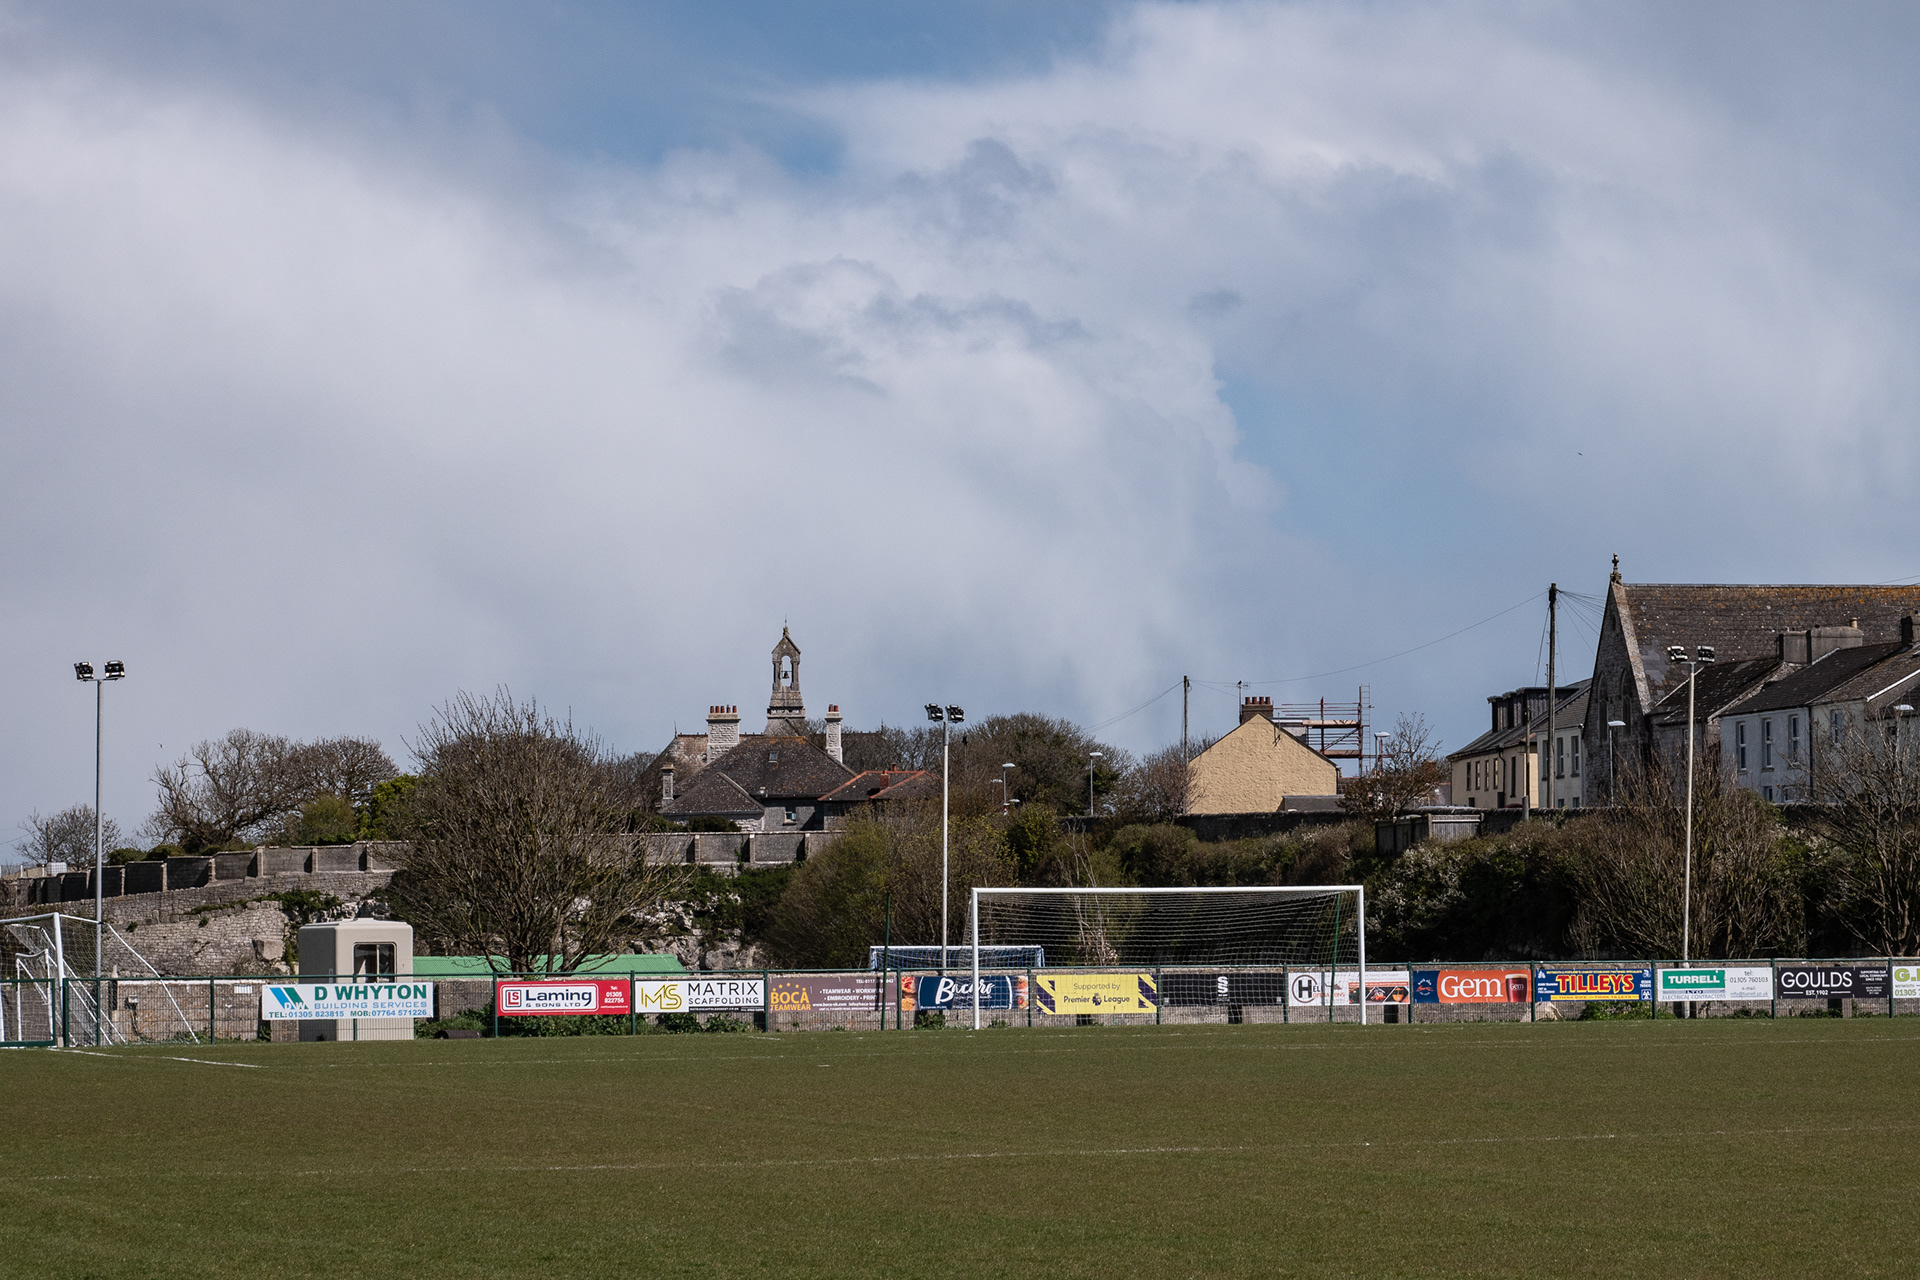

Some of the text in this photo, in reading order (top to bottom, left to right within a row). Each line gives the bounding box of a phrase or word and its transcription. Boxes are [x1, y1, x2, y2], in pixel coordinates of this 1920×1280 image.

[1441, 976, 1503, 998] Gem
[1556, 974, 1634, 994] TILLEYS
[1668, 975, 1720, 984] TURRELL
[1781, 972, 1852, 988] GOULDS
[315, 985, 427, 1000] D WHYTON
[688, 982, 758, 996] MATRIX
[526, 989, 592, 1006] Laming
[771, 992, 810, 1004] BOCA
[1104, 996, 1130, 1004] League
